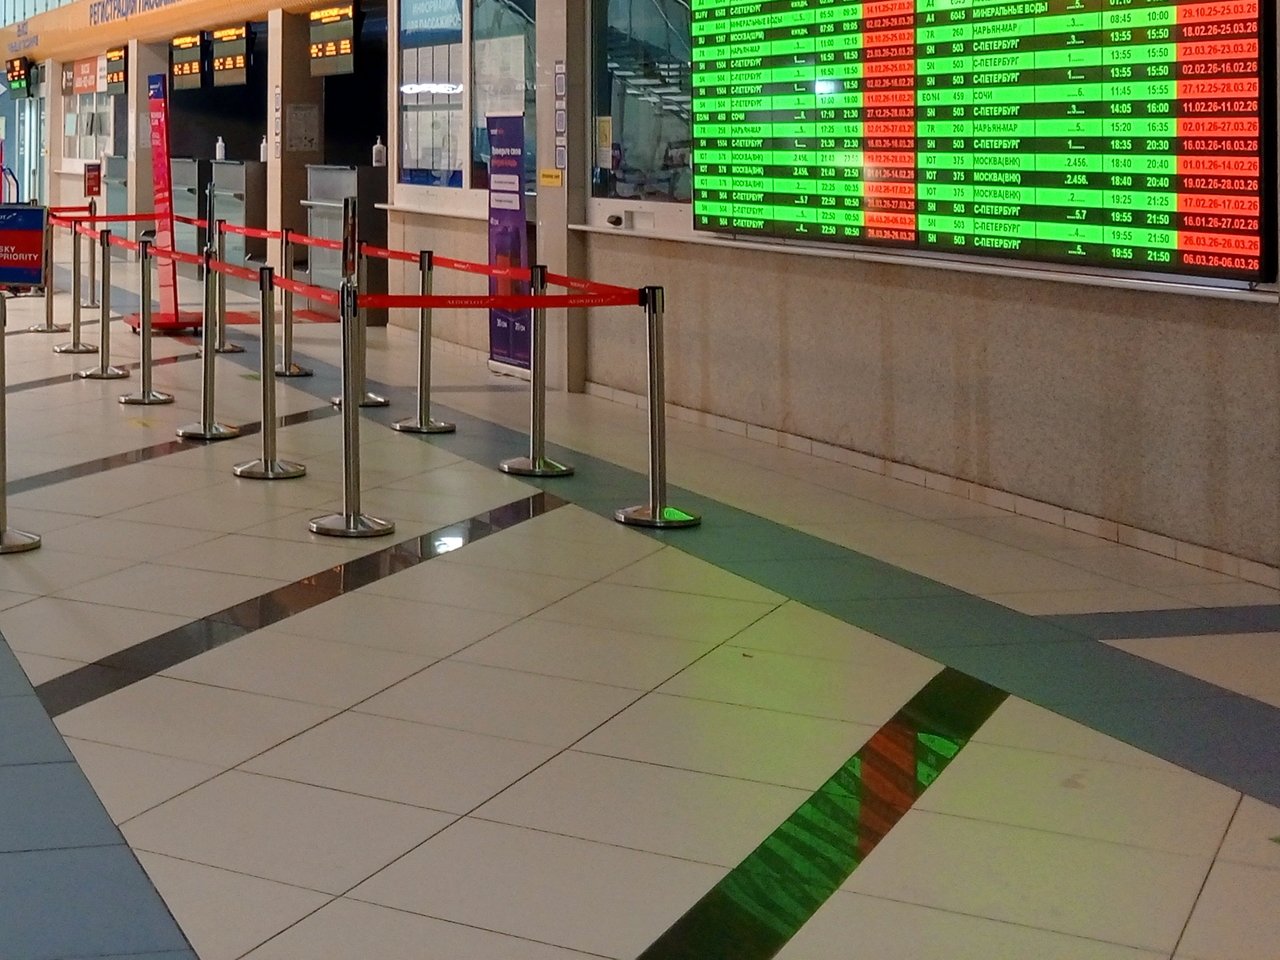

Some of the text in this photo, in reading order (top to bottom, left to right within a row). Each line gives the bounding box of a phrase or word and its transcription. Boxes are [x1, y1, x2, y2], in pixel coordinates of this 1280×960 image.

[1148, 10, 1169, 21] 10:00
[973, 28, 1169, 52] С-ПЕТЕРБУРГ 13:55 15:50
[973, 48, 1169, 68] С-ПЕТЕРБУРГ 13:55 15:50
[973, 65, 1169, 83] С-ПЕТЕРБУРГ 13:55 15:50
[974, 85, 1169, 100] СОЧИ 11:45 15:55
[974, 102, 1169, 116] С-ПЕТЕРБУРГ 14:05 16:00
[1111, 122, 1169, 132] 15:20 16:35
[974, 139, 1169, 151] С-ПЕТЕРБУРГ 18:35 20:30
[1111, 158, 1169, 169] 18:40 20:40
[1111, 176, 1169, 188] 18:40 20:40
[1112, 194, 1169, 206] 19:25 21:25
[974, 204, 1169, 225] С-ПЕТЕРБУРГ 19:55 21:50
[1112, 230, 1170, 244] 19:55 21:50
[974, 239, 1170, 262] С-ПЕТЕРБУРГ 19:55 21:50
